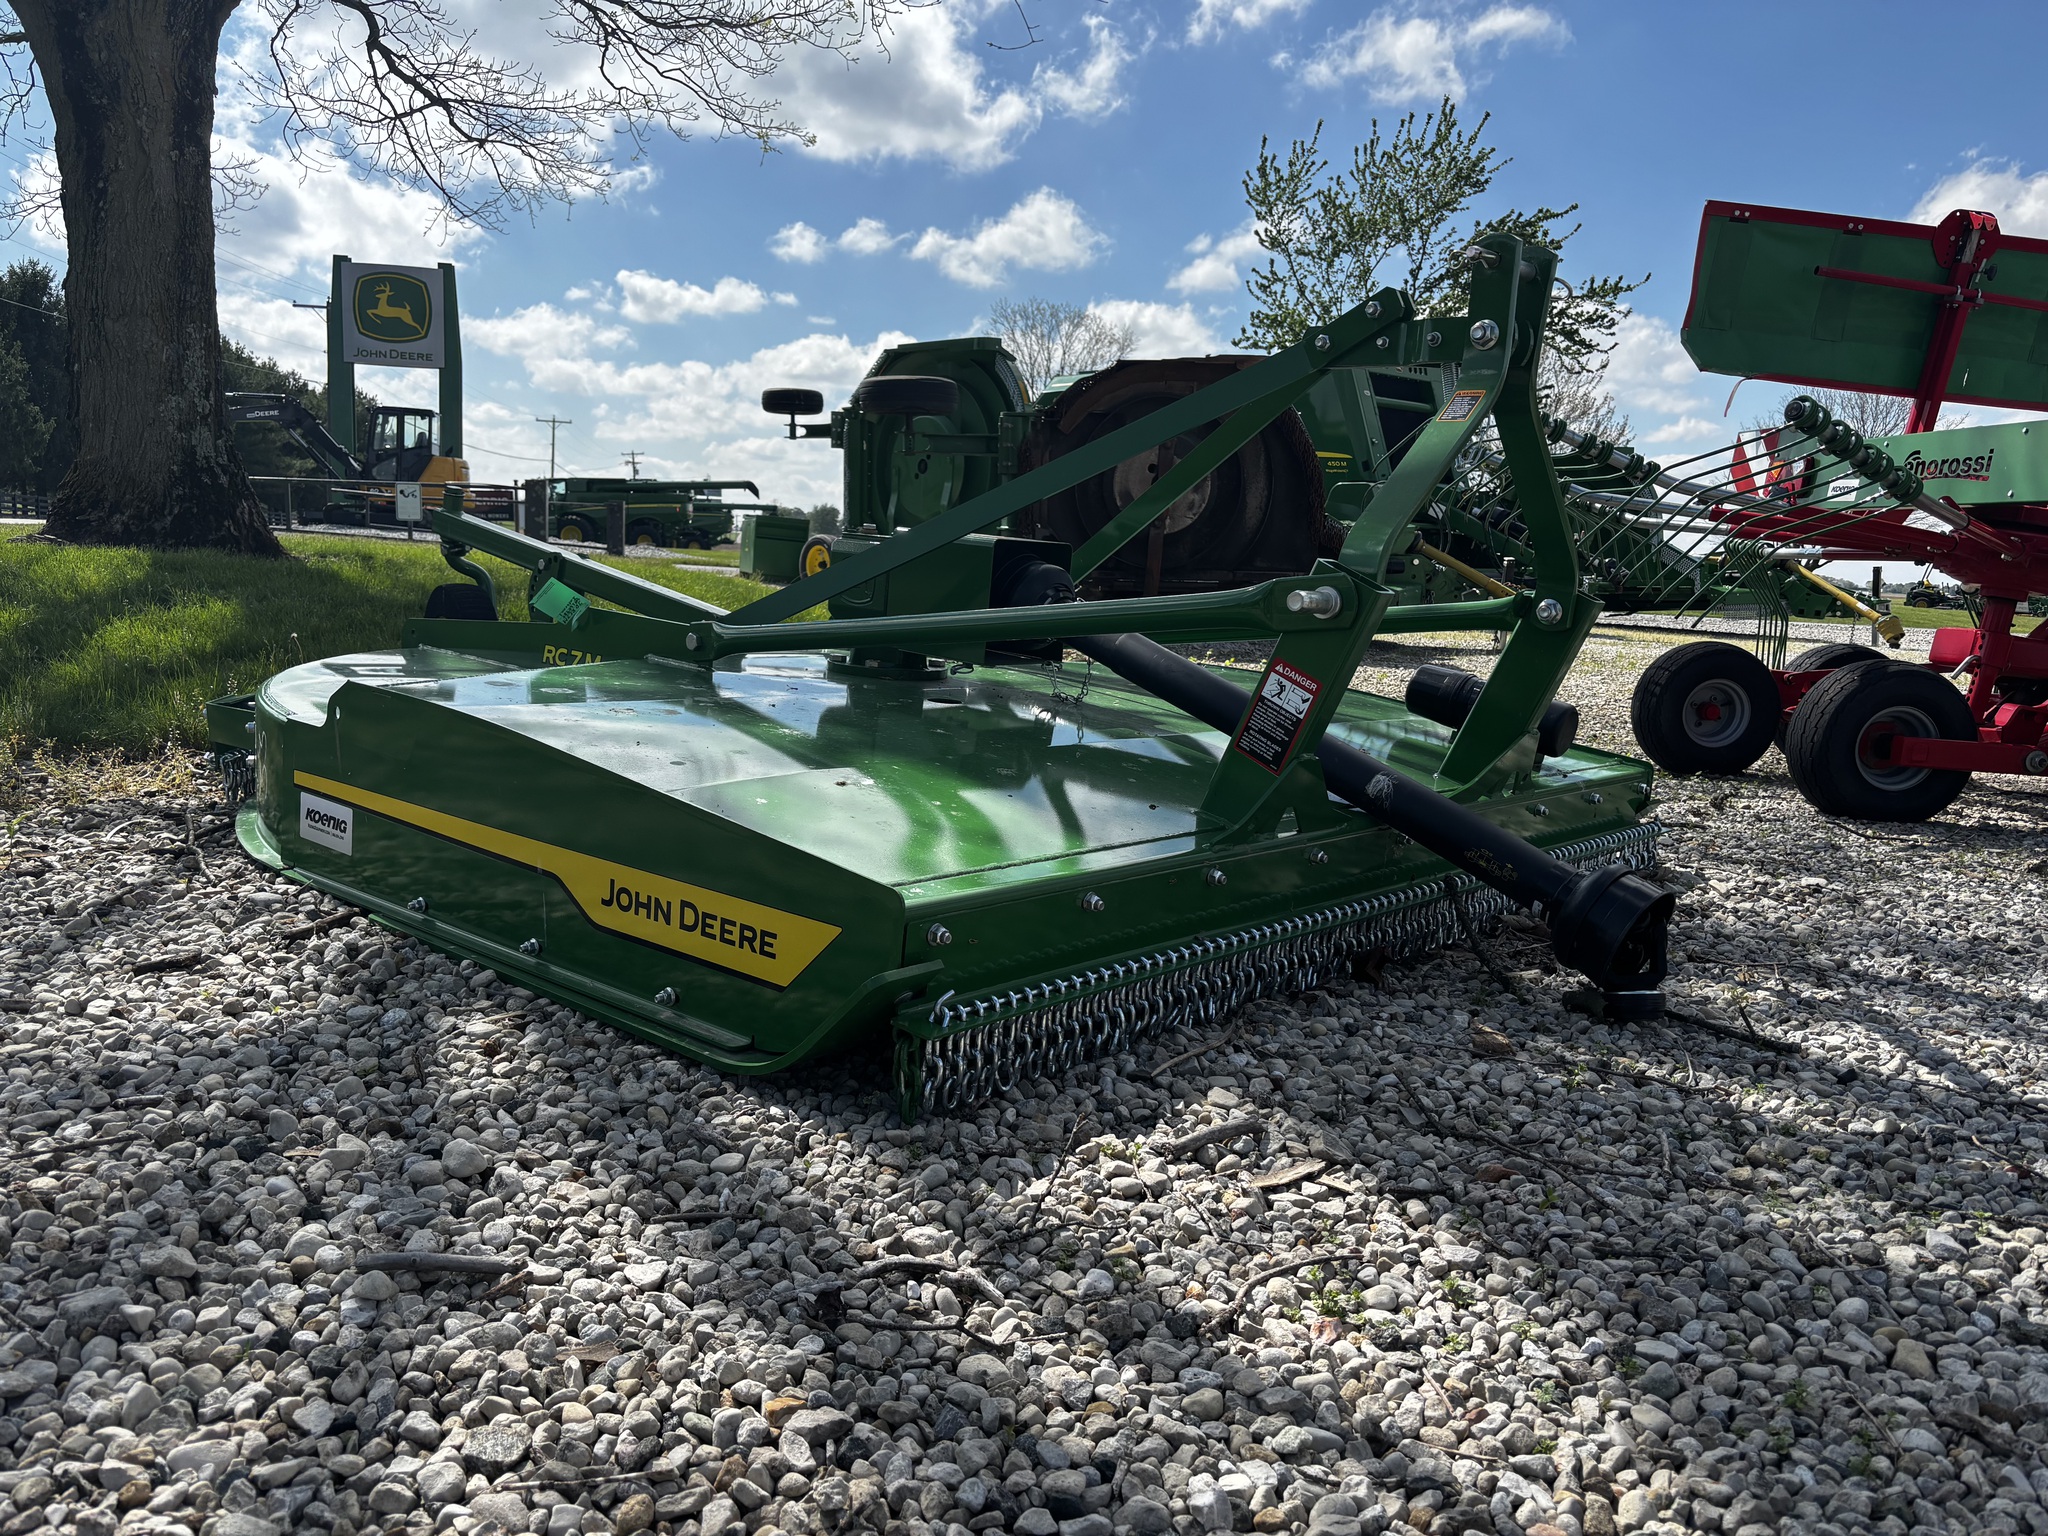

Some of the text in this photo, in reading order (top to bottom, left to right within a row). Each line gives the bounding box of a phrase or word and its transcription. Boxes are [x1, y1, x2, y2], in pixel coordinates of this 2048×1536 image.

[353, 347, 434, 362] JOHN DEERE
[1284, 667, 1318, 692] DANGER
[600, 878, 778, 960] JOHN DEERE
